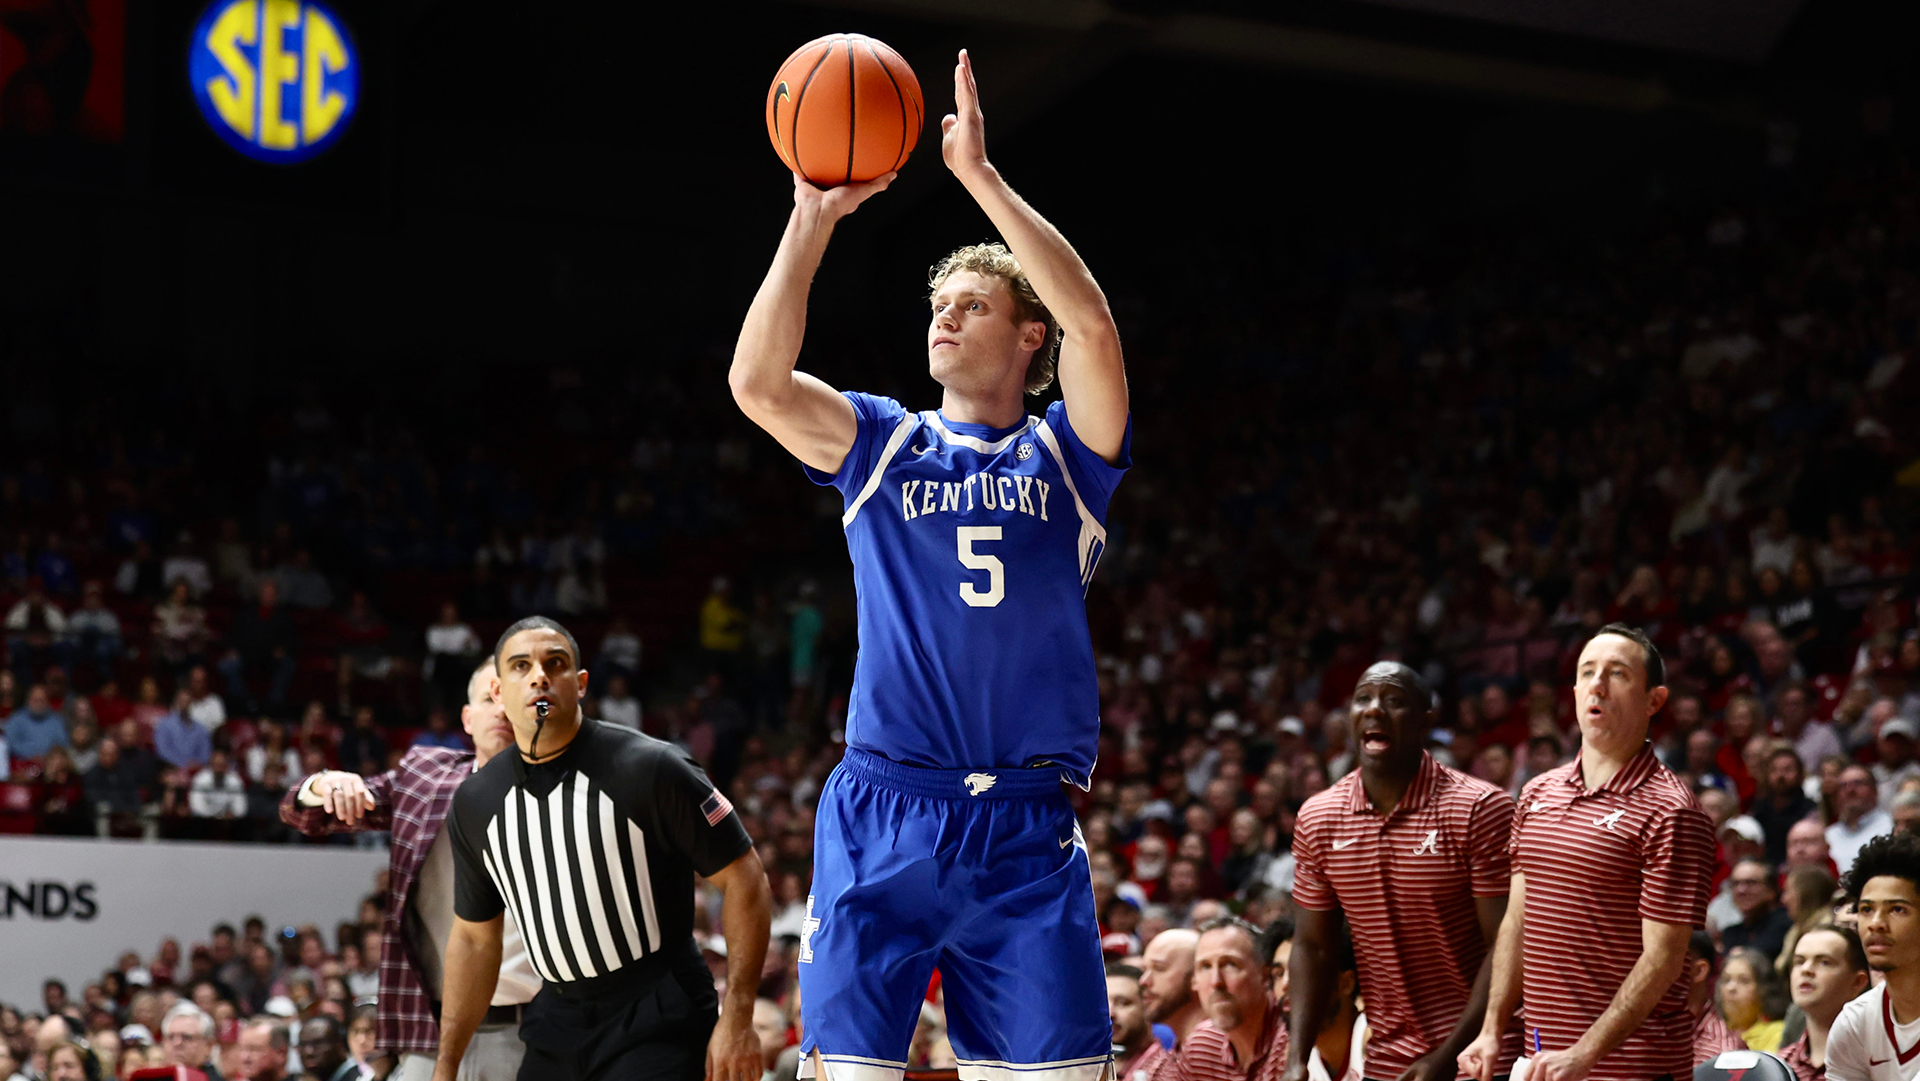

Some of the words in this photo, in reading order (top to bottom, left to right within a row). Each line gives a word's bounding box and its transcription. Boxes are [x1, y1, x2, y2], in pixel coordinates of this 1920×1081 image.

[206, 0, 348, 149] SEC
[1015, 444, 1033, 460] SEC
[902, 472, 1050, 522] KENTUCKY
[956, 526, 1005, 607] 5
